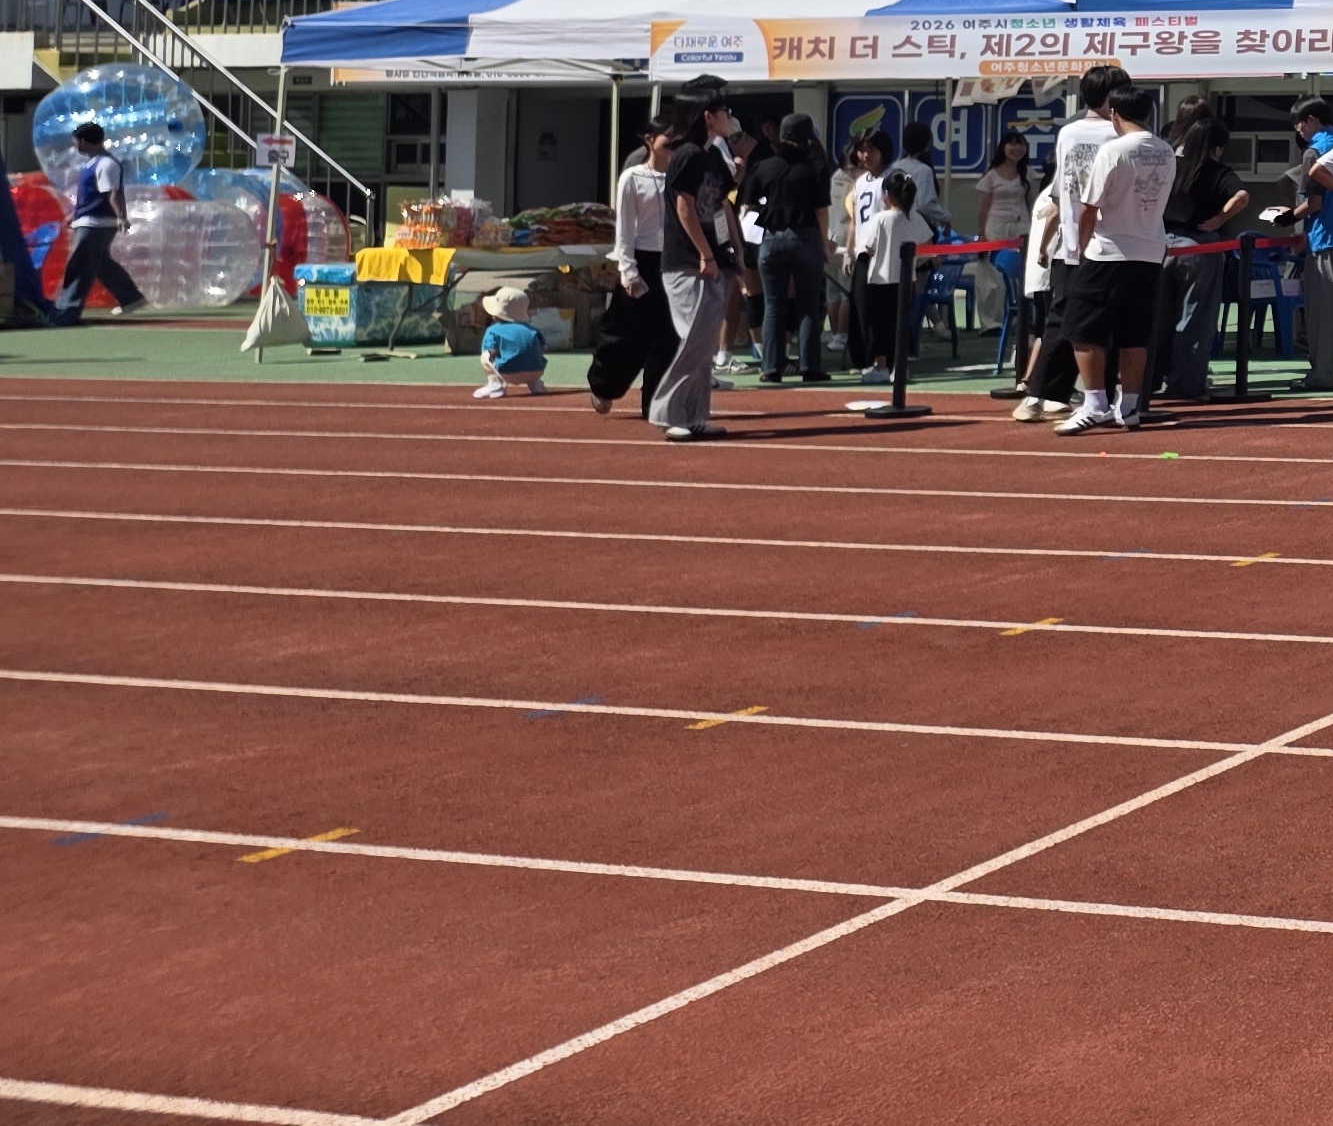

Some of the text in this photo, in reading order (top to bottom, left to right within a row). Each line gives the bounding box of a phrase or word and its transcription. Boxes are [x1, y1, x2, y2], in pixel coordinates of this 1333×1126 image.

[911, 20, 956, 31] 2026
[1064, 16, 1128, 28] 생활체육
[1135, 15, 1199, 27] 페스티벌
[674, 35, 744, 49] 다채로운 여주
[773, 35, 837, 61] 캐치
[850, 35, 879, 59] 더
[892, 33, 967, 61] 스틱,
[980, 32, 1070, 57] 제2의
[1083, 29, 1223, 57] 제구왕을
[681, 53, 737, 62] Colorful Yeoju
